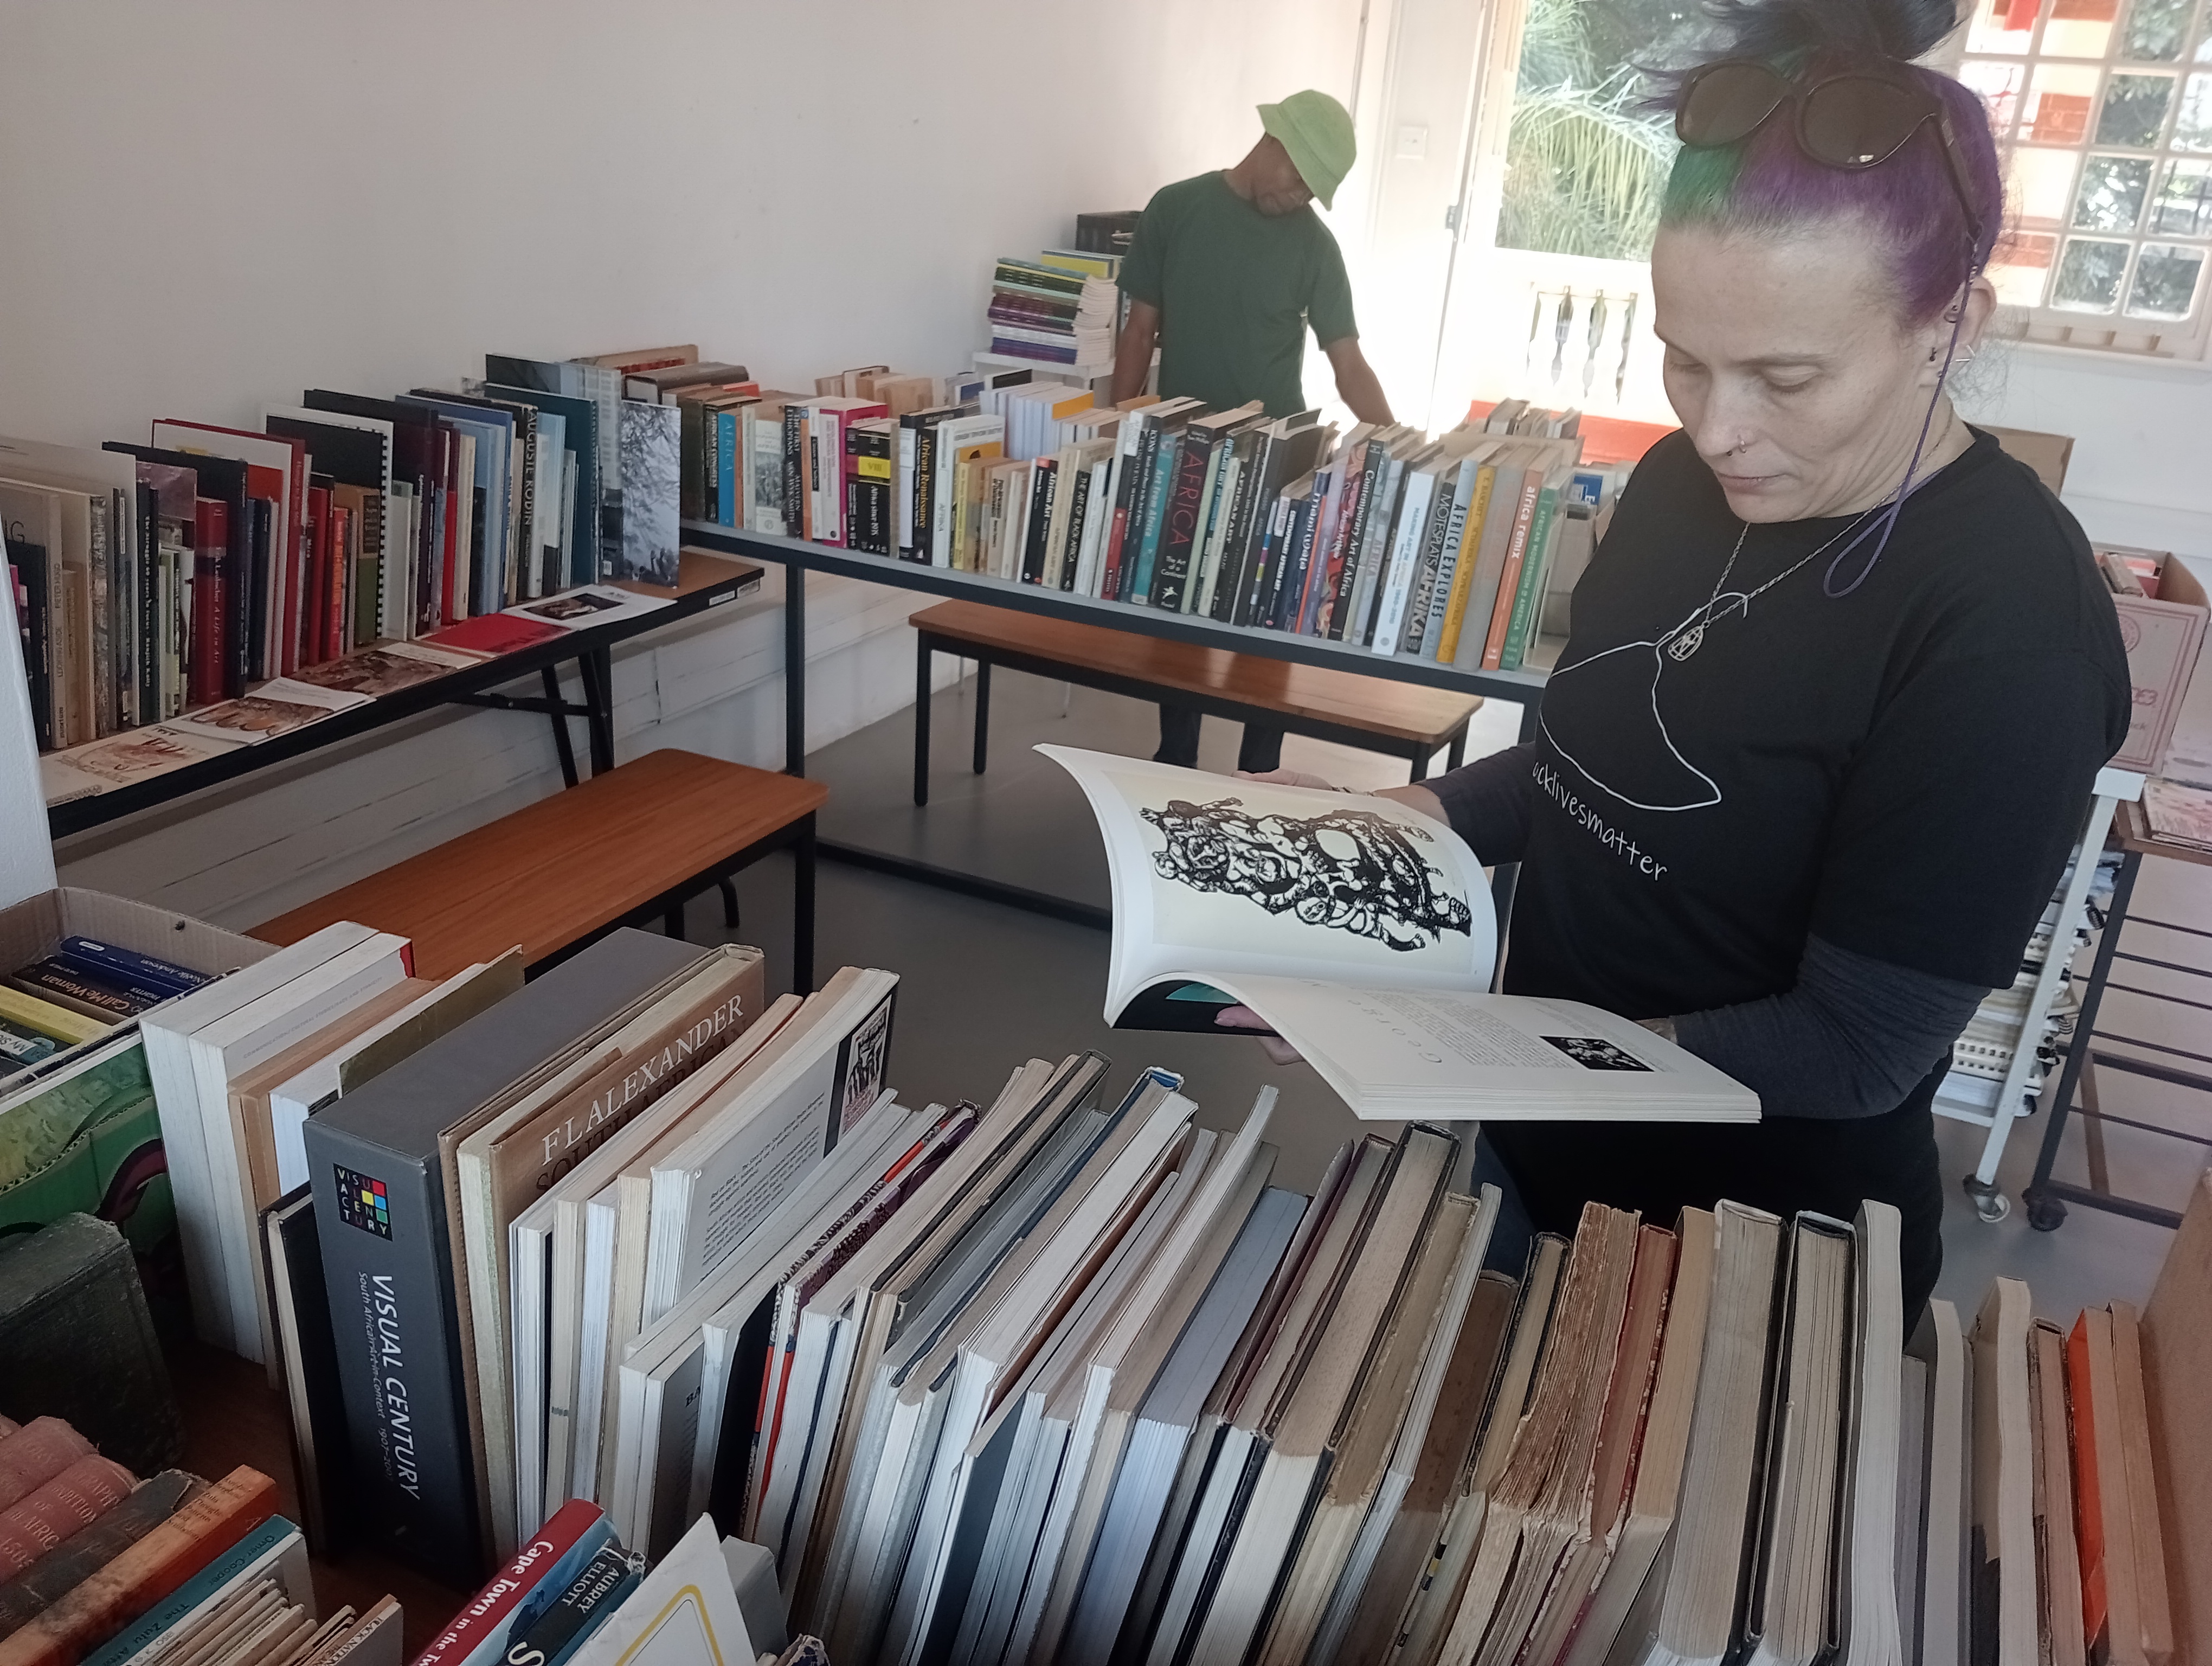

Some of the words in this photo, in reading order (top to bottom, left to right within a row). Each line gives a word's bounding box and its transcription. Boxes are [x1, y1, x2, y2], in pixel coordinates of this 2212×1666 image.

[922, 438, 930, 471] African
[1148, 430, 1158, 452] ICONS
[1046, 472, 1057, 504] African
[1155, 469, 1165, 486] Art
[524, 479, 535, 527] RODIN
[919, 474, 930, 528] Renaissance
[1044, 504, 1052, 517] Art
[1150, 486, 1161, 508] from
[1170, 451, 1204, 545] AFRICA
[1232, 471, 1245, 520] AFRICAN
[1351, 470, 1375, 536] Contemporary
[1520, 485, 1536, 521] africa
[1144, 510, 1156, 537] Africa
[1445, 503, 1467, 550] AFRICA
[1348, 537, 1359, 556] Art
[1512, 524, 1526, 559] remix
[1346, 557, 1356, 570] of
[1340, 569, 1353, 597] Africa
[1431, 555, 1457, 618] EXPLORES
[1408, 565, 1437, 638] AFRIKA
[1532, 762, 1668, 881] acklivesmatter
[41, 974, 85, 996] Woman
[86, 990, 101, 1002] Me
[103, 997, 130, 1010] Call
[586, 994, 744, 1133] ALEXANDER
[358, 1271, 369, 1302] South
[362, 1304, 377, 1344] African
[372, 1274, 403, 1368] VISUAL
[372, 1375, 385, 1418] Context
[385, 1376, 420, 1500] CENTURY
[209, 1534, 276, 1586] Omer-Cooper
[511, 1541, 554, 1575] Cape
[470, 1578, 521, 1616] Town
[561, 1561, 606, 1606] ELLIOTT
[577, 1566, 620, 1614] AUBREY
[133, 1622, 162, 1645] Zulu
[435, 1631, 458, 1651] the
[456, 1618, 474, 1630] in
[418, 1654, 442, 1666] Tw
[508, 1641, 545, 1666] S
